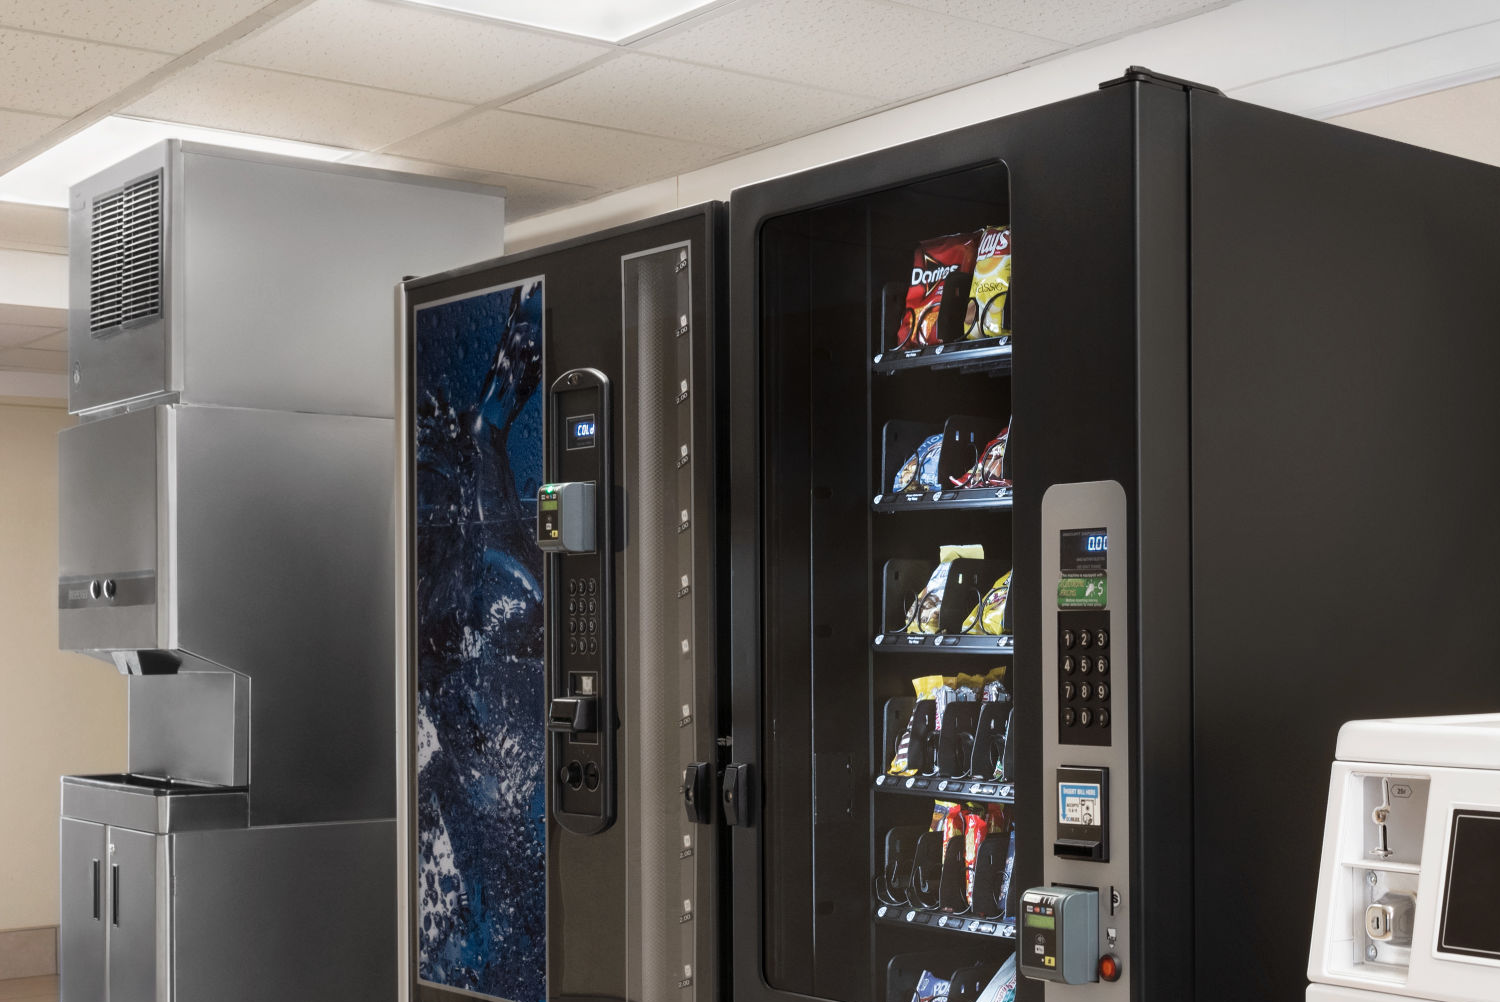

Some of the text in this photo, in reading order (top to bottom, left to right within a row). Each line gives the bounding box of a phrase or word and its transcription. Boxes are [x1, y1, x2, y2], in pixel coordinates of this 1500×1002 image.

[675, 260, 687, 273] 2.00
[676, 326, 688, 337] 2.00
[676, 391, 688, 404] 2.00
[1065, 633, 1104, 646] 1 2 3
[1064, 659, 1104, 672] 4 5 6
[1065, 685, 1104, 699] 7 8 9
[1081, 711, 1087, 725] 0
